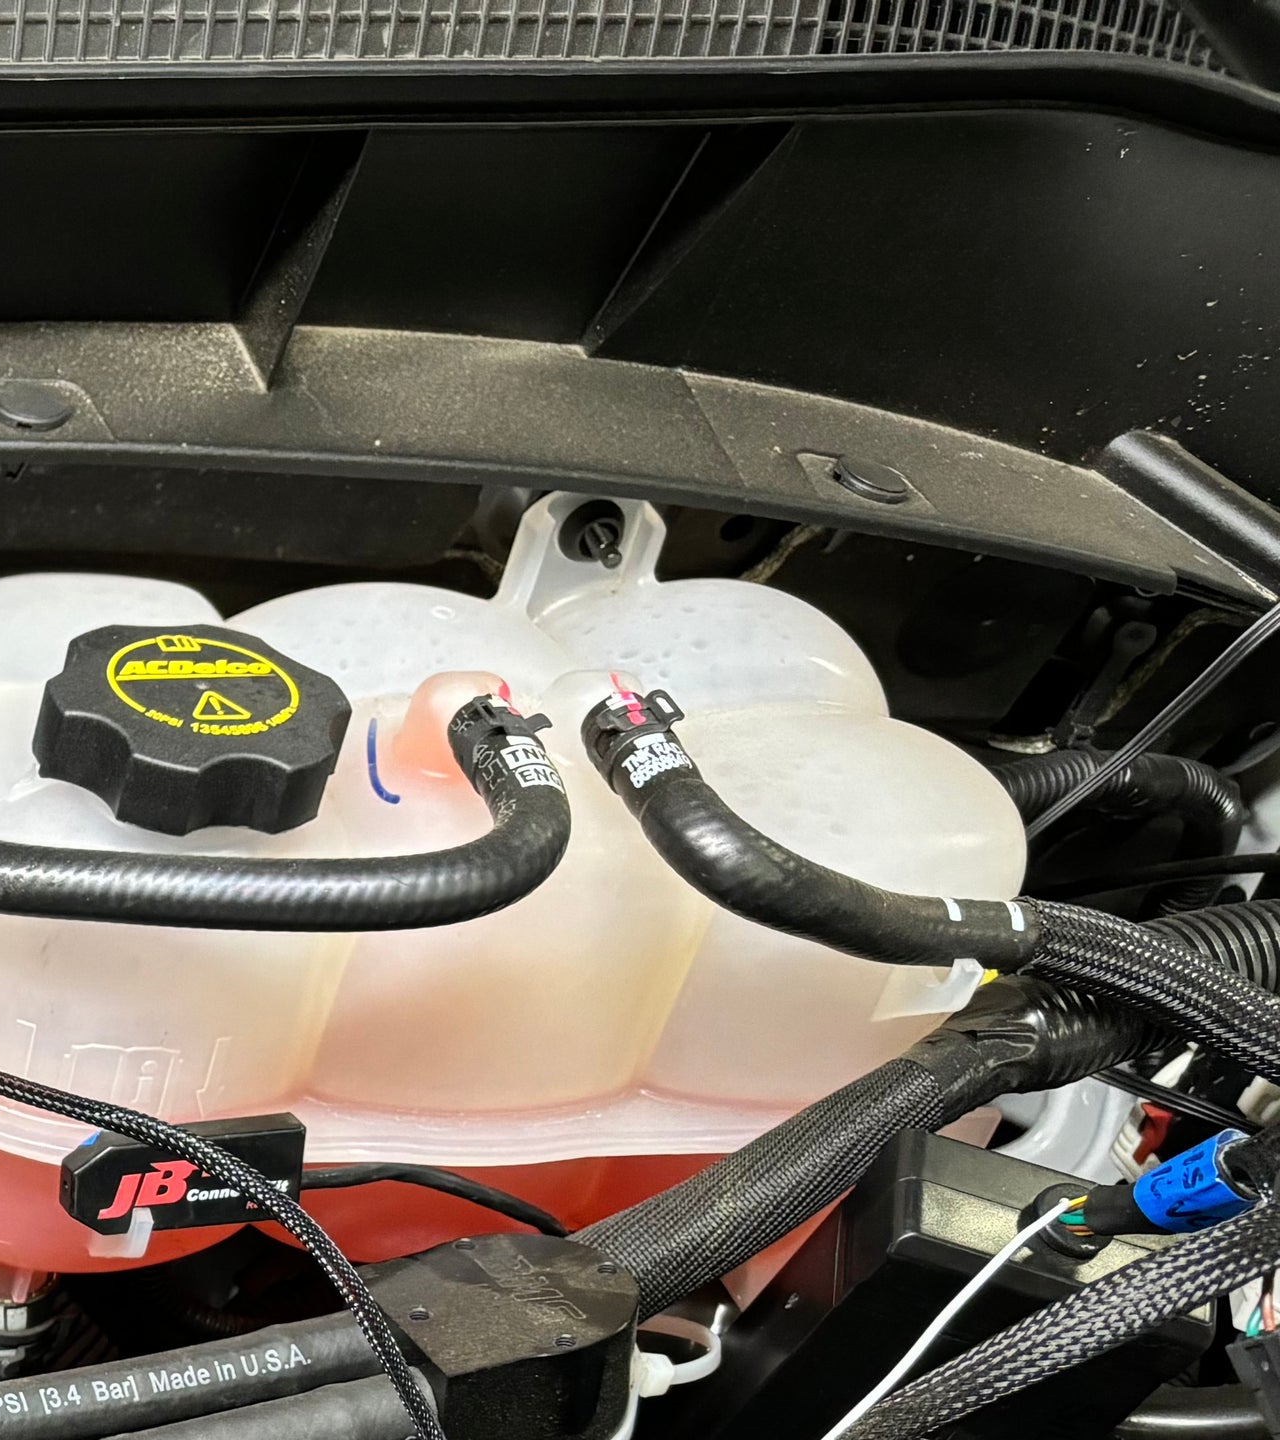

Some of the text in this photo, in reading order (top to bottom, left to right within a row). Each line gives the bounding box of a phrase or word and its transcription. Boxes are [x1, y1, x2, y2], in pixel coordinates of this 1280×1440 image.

[119, 660, 273, 675] ACDelco
[518, 768, 561, 785] ENG
[41, 1384, 82, 1415] [3.4
[93, 1375, 140, 1403] Bar]
[149, 1365, 211, 1395] Made
[216, 1360, 237, 1382] in
[240, 1343, 312, 1378] U.S.A.
